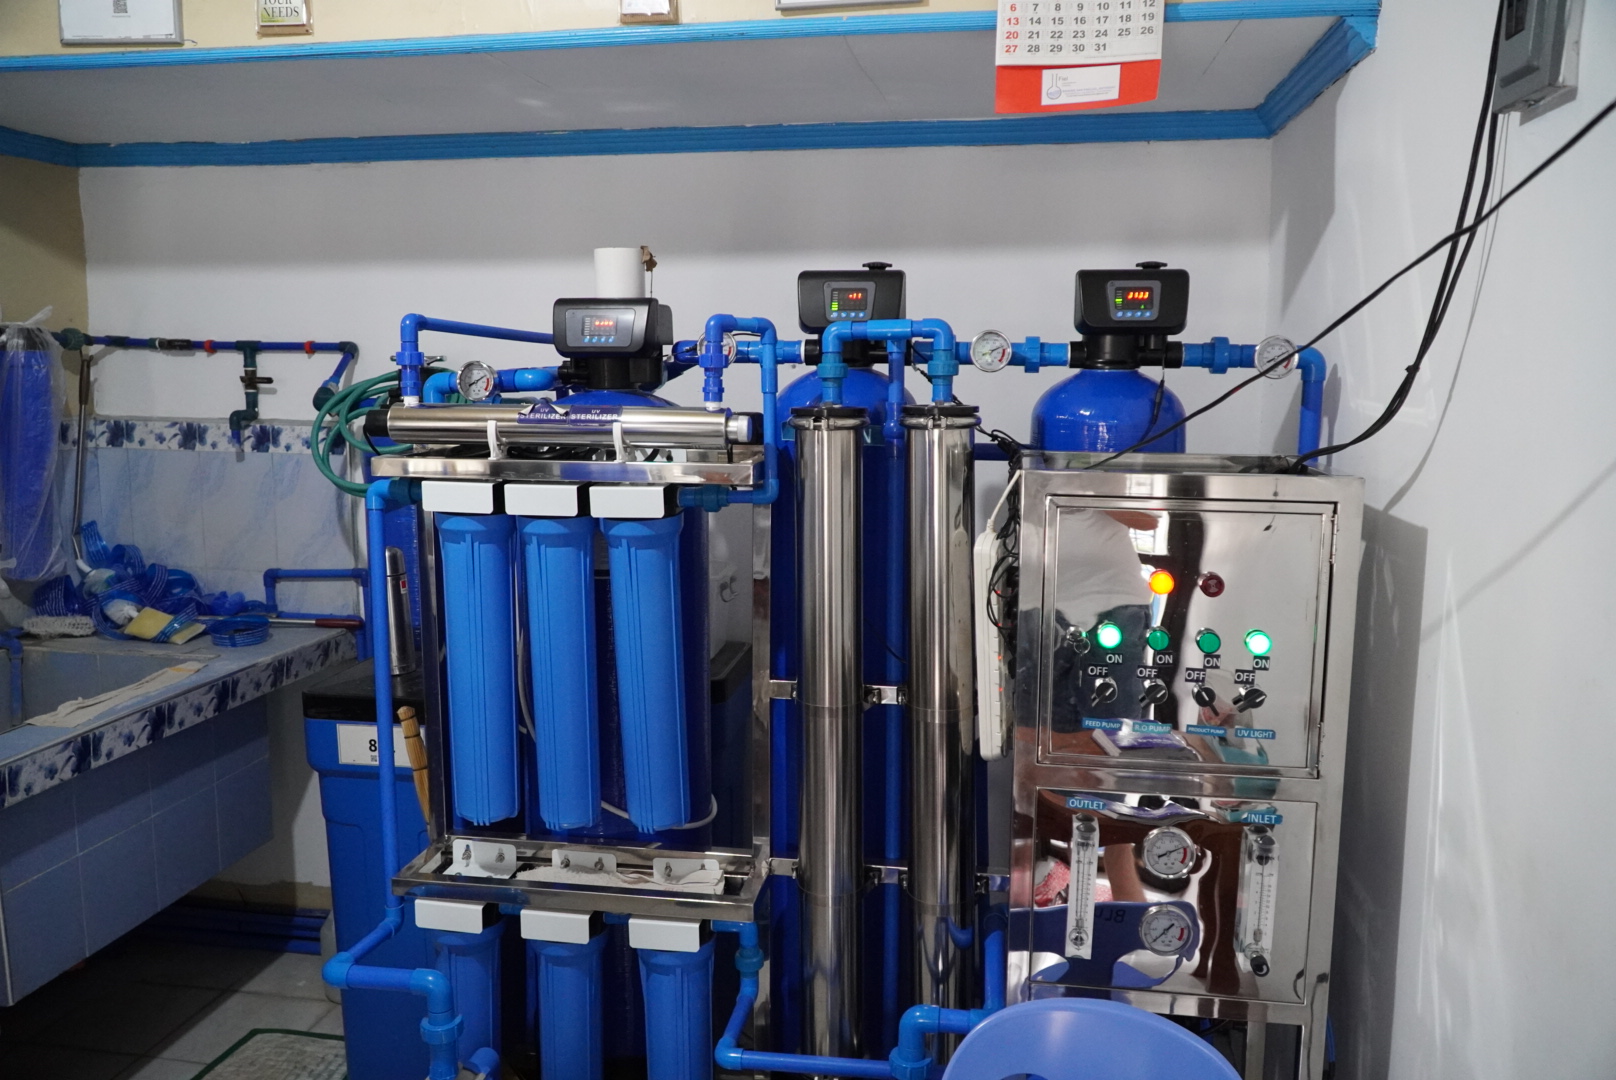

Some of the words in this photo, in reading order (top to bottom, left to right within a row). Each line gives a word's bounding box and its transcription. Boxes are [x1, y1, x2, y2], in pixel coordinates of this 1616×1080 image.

[263, 6, 300, 18] NEEDS
[1010, 3, 1017, 12] 6
[1032, 3, 1039, 12] 7
[1054, 3, 1061, 12] 8
[1077, 2, 1084, 11] 9
[1097, 2, 1110, 11] 10
[1120, 1, 1132, 9] 11
[1006, 17, 1020, 26] 13
[1029, 17, 1042, 26] 14
[1051, 17, 1064, 26] 15
[1073, 16, 1087, 25] 16
[1096, 16, 1109, 25] 17
[1119, 14, 1132, 23] 18
[1141, 12, 1155, 21] 19
[1005, 31, 1019, 40] 20
[1028, 31, 1040, 39] 21
[1050, 31, 1063, 39] 22
[1072, 30, 1086, 39] 23
[1094, 29, 1108, 38] 24
[1117, 28, 1131, 37] 25
[1140, 26, 1154, 35] 26
[1005, 44, 1018, 53] 27
[1027, 44, 1040, 53] 28
[1049, 44, 1063, 53] 29
[1072, 43, 1085, 52] 30
[1094, 43, 1107, 52] 31
[1106, 654, 1123, 664] ON
[1156, 654, 1173, 664] ON
[1204, 657, 1220, 667] ON
[1253, 658, 1270, 669] ON
[1088, 666, 1108, 676] OFF
[1137, 667, 1158, 678] OFF
[1185, 670, 1206, 681] OFF
[1234, 672, 1256, 683] OFF
[1101, 721, 1121, 729] PUMP
[1134, 724, 1148, 732] R.O
[1188, 726, 1210, 734] PRODUCT
[1250, 731, 1274, 739] LIGHT
[1069, 799, 1104, 811] OUTLET
[1248, 813, 1278, 825] INLET
